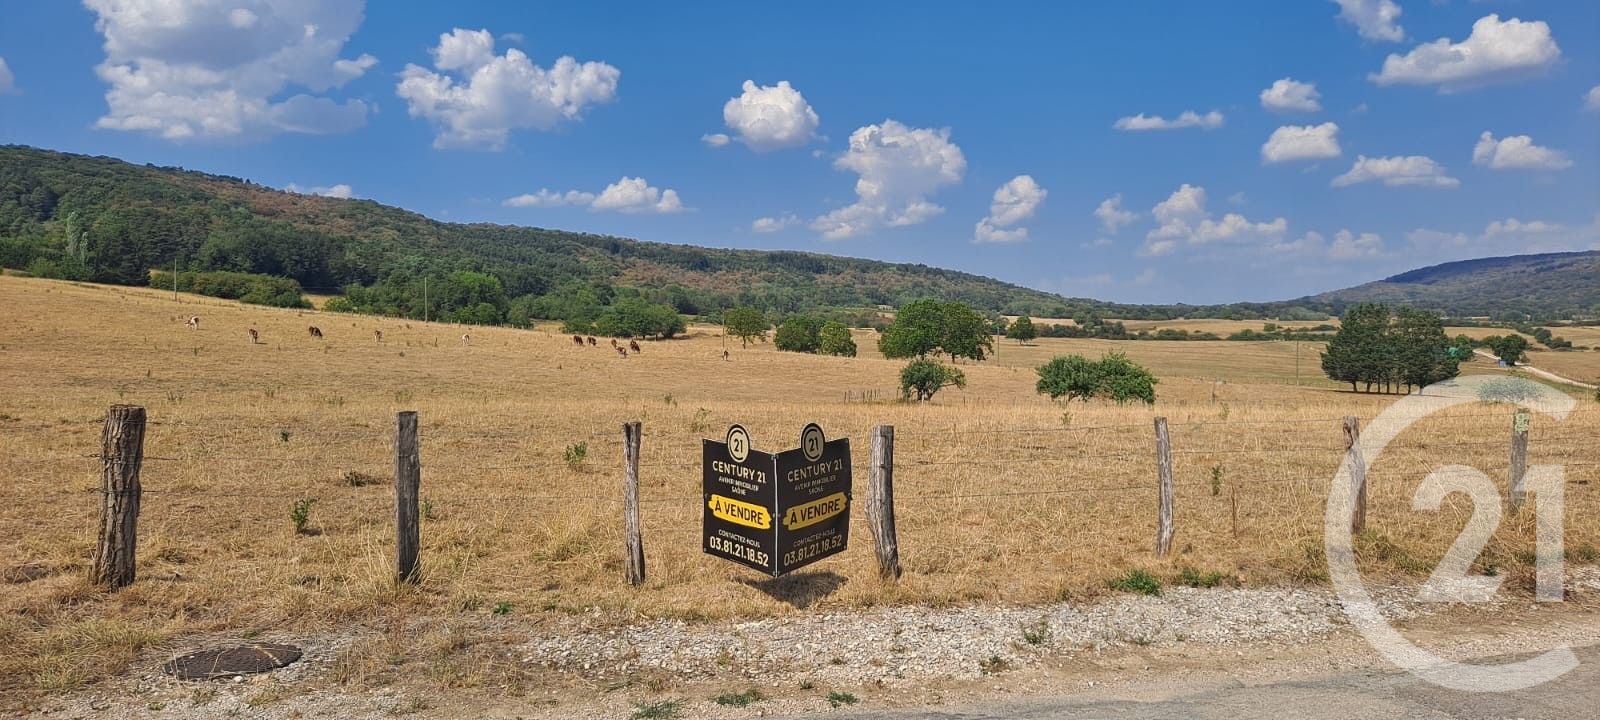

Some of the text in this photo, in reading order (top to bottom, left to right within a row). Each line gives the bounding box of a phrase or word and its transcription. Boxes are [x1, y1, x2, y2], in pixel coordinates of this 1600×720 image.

[733, 438, 744, 454] 21
[808, 437, 819, 453] 21
[712, 460, 767, 484] CENTURY 21
[787, 458, 843, 482] CENTURY 21
[724, 501, 764, 526] VENDRE
[800, 498, 841, 522] VENDRE
[709, 535, 769, 567] 03.81.21.18.52
[783, 534, 842, 567] 03.81.21.18.52
